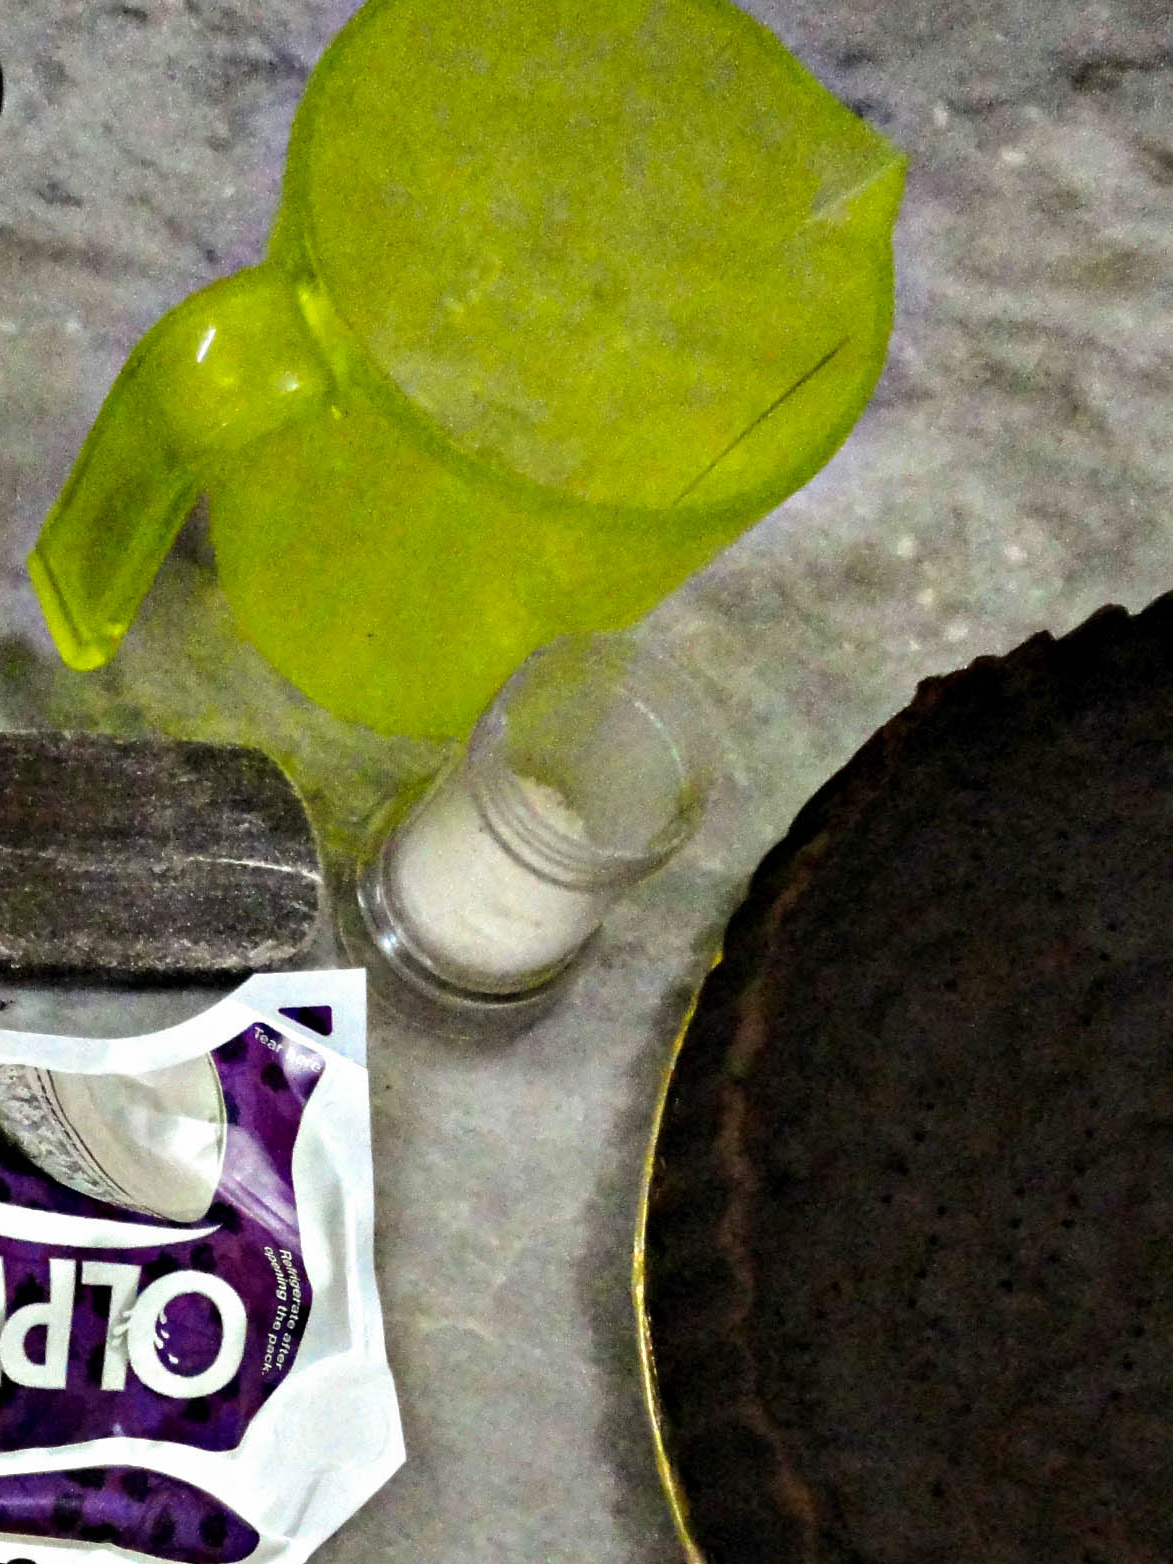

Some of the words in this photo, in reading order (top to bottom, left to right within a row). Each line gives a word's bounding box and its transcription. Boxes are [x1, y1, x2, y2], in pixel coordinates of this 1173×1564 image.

[253, 1026, 284, 1053] Tear
[263, 1246, 288, 1301] opening
[278, 1249, 302, 1330] Refrigerate
[272, 1305, 288, 1331] the
[261, 1333, 278, 1376] pack.
[275, 1332, 292, 1371] after
